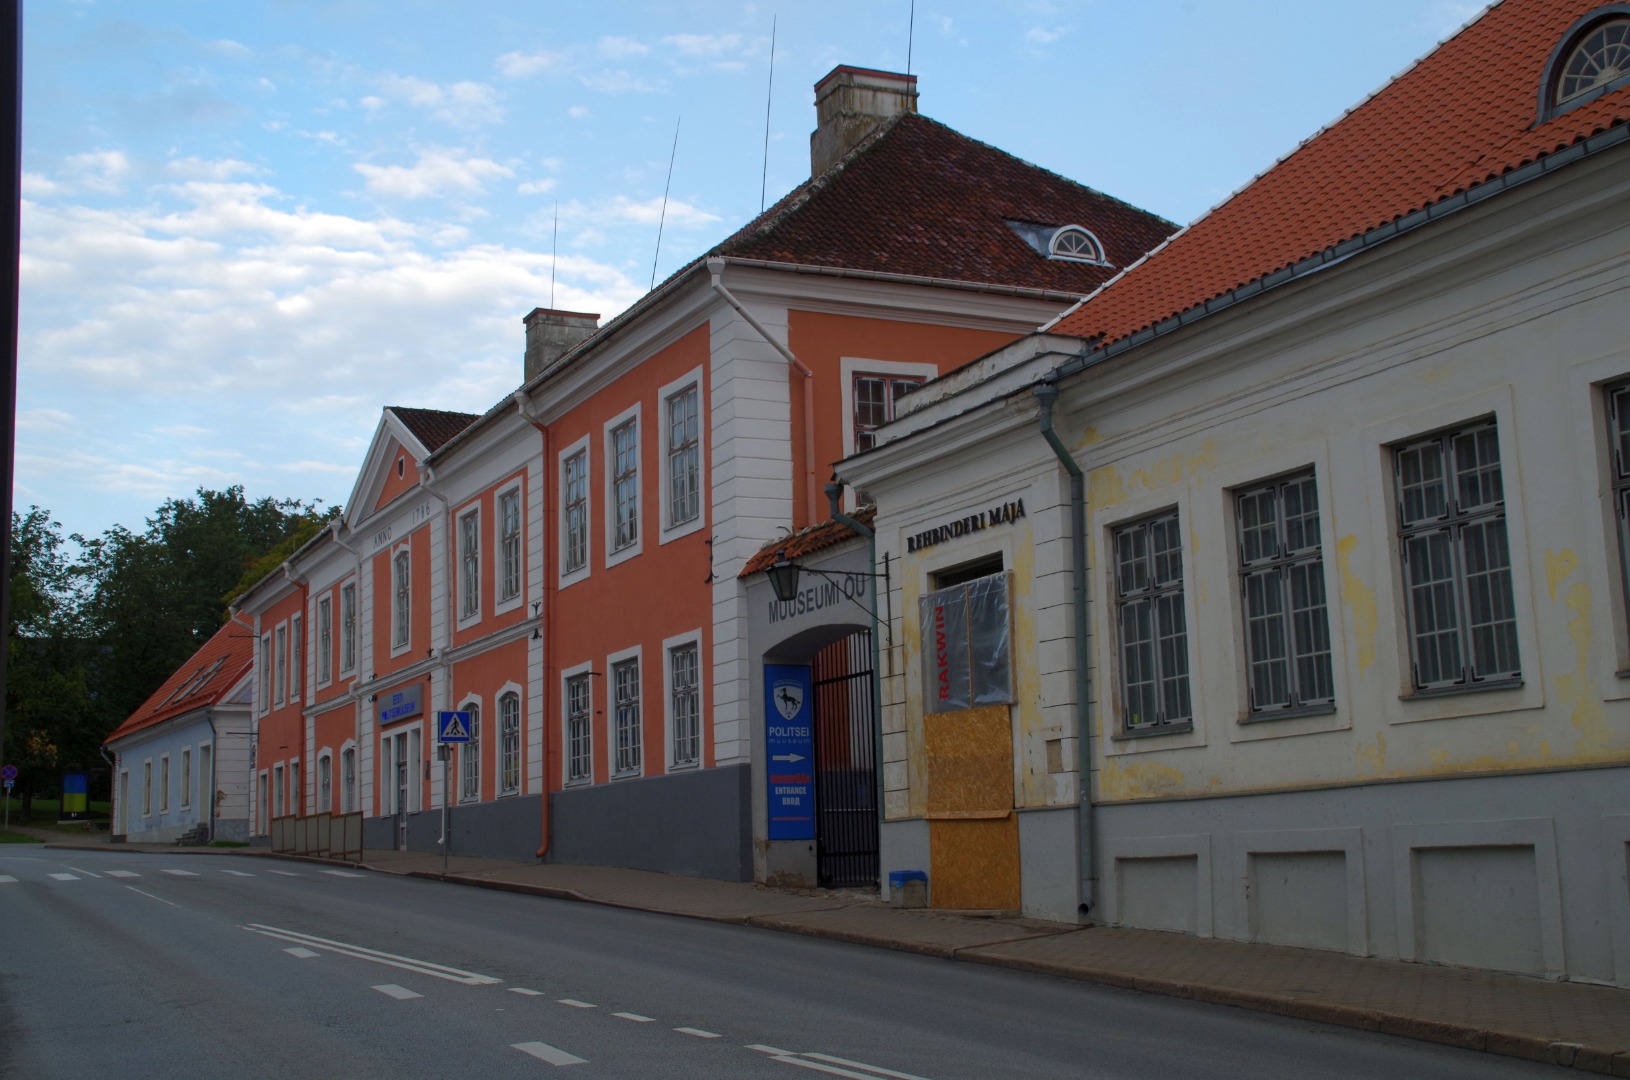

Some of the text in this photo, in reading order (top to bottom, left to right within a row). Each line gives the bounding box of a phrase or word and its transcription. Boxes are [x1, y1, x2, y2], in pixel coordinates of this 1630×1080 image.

[373, 501, 430, 550] ANNO 1786
[906, 497, 1026, 554] REHBINDERI MAJA
[768, 579, 840, 625] MUUSEUMI
[934, 605, 950, 700] RAKWIN
[769, 726, 810, 737] POLITSEI
[775, 786, 807, 795] ENTRANCE
[782, 797, 801, 807] ВХОД
